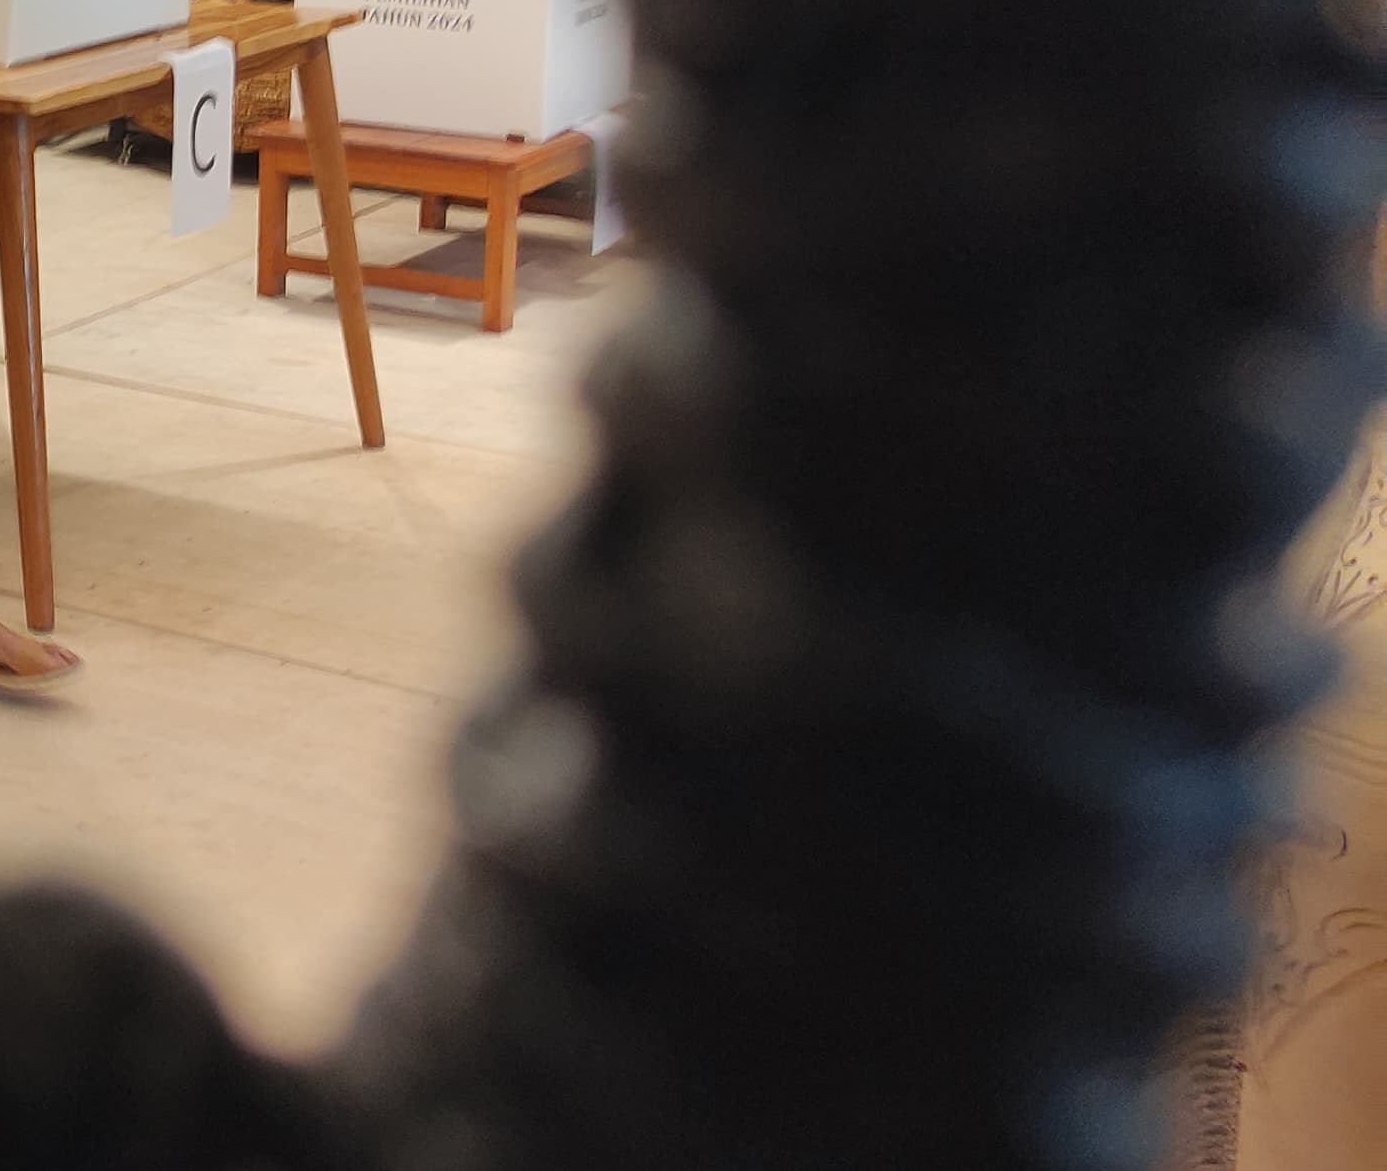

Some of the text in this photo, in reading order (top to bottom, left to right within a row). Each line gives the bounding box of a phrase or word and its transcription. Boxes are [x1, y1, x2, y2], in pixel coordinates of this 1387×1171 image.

[361, 7, 476, 32] TAHUN 2024
[190, 93, 217, 178] C
